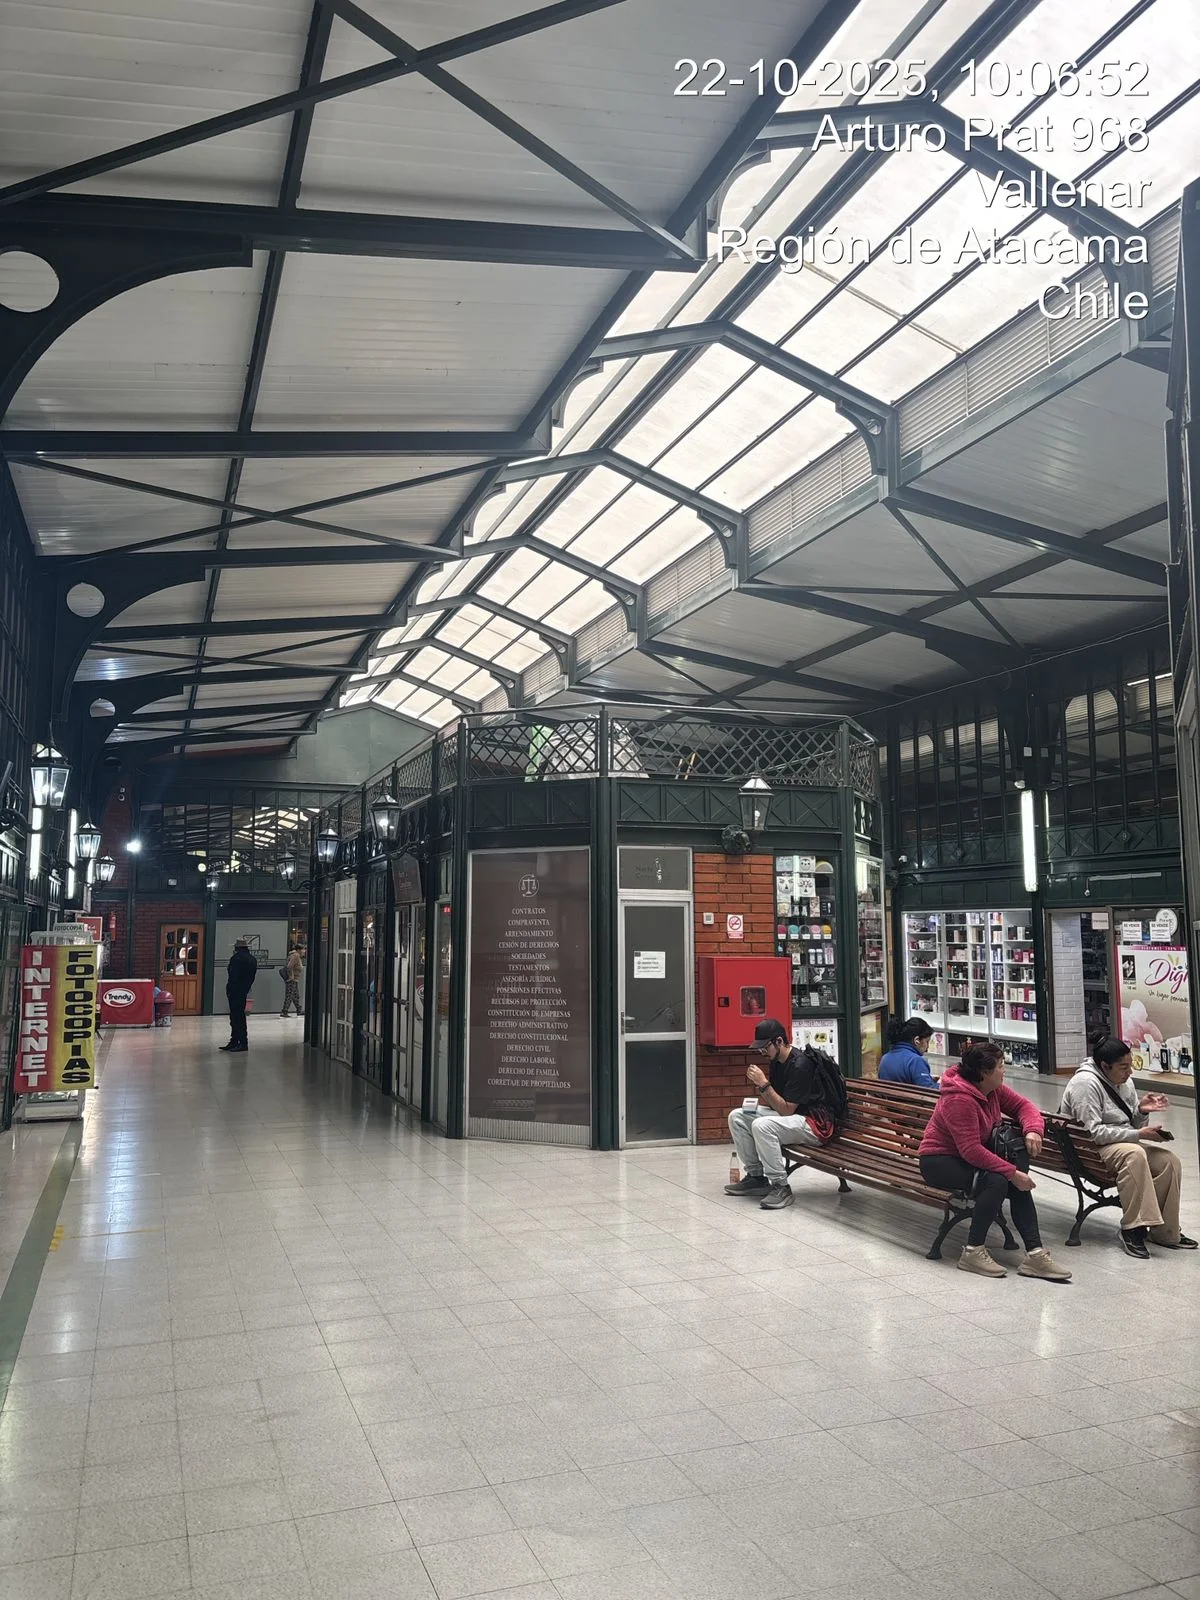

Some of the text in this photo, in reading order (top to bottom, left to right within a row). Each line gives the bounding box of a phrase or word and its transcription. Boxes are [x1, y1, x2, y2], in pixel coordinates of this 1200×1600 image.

[529, 974, 556, 982] JURÍDICA
[107, 993, 131, 1001] Trendy
[488, 1009, 530, 1017] CONSTITUCIÓN
[20, 951, 50, 1087] INTERNET
[62, 951, 94, 1084] FOTOCOPIAS
[518, 1033, 568, 1041] CONSTITUCIONAL
[530, 1056, 556, 1064] LABORAL
[521, 1079, 529, 1087] DE
[530, 1080, 571, 1088] PROPIEDADES
